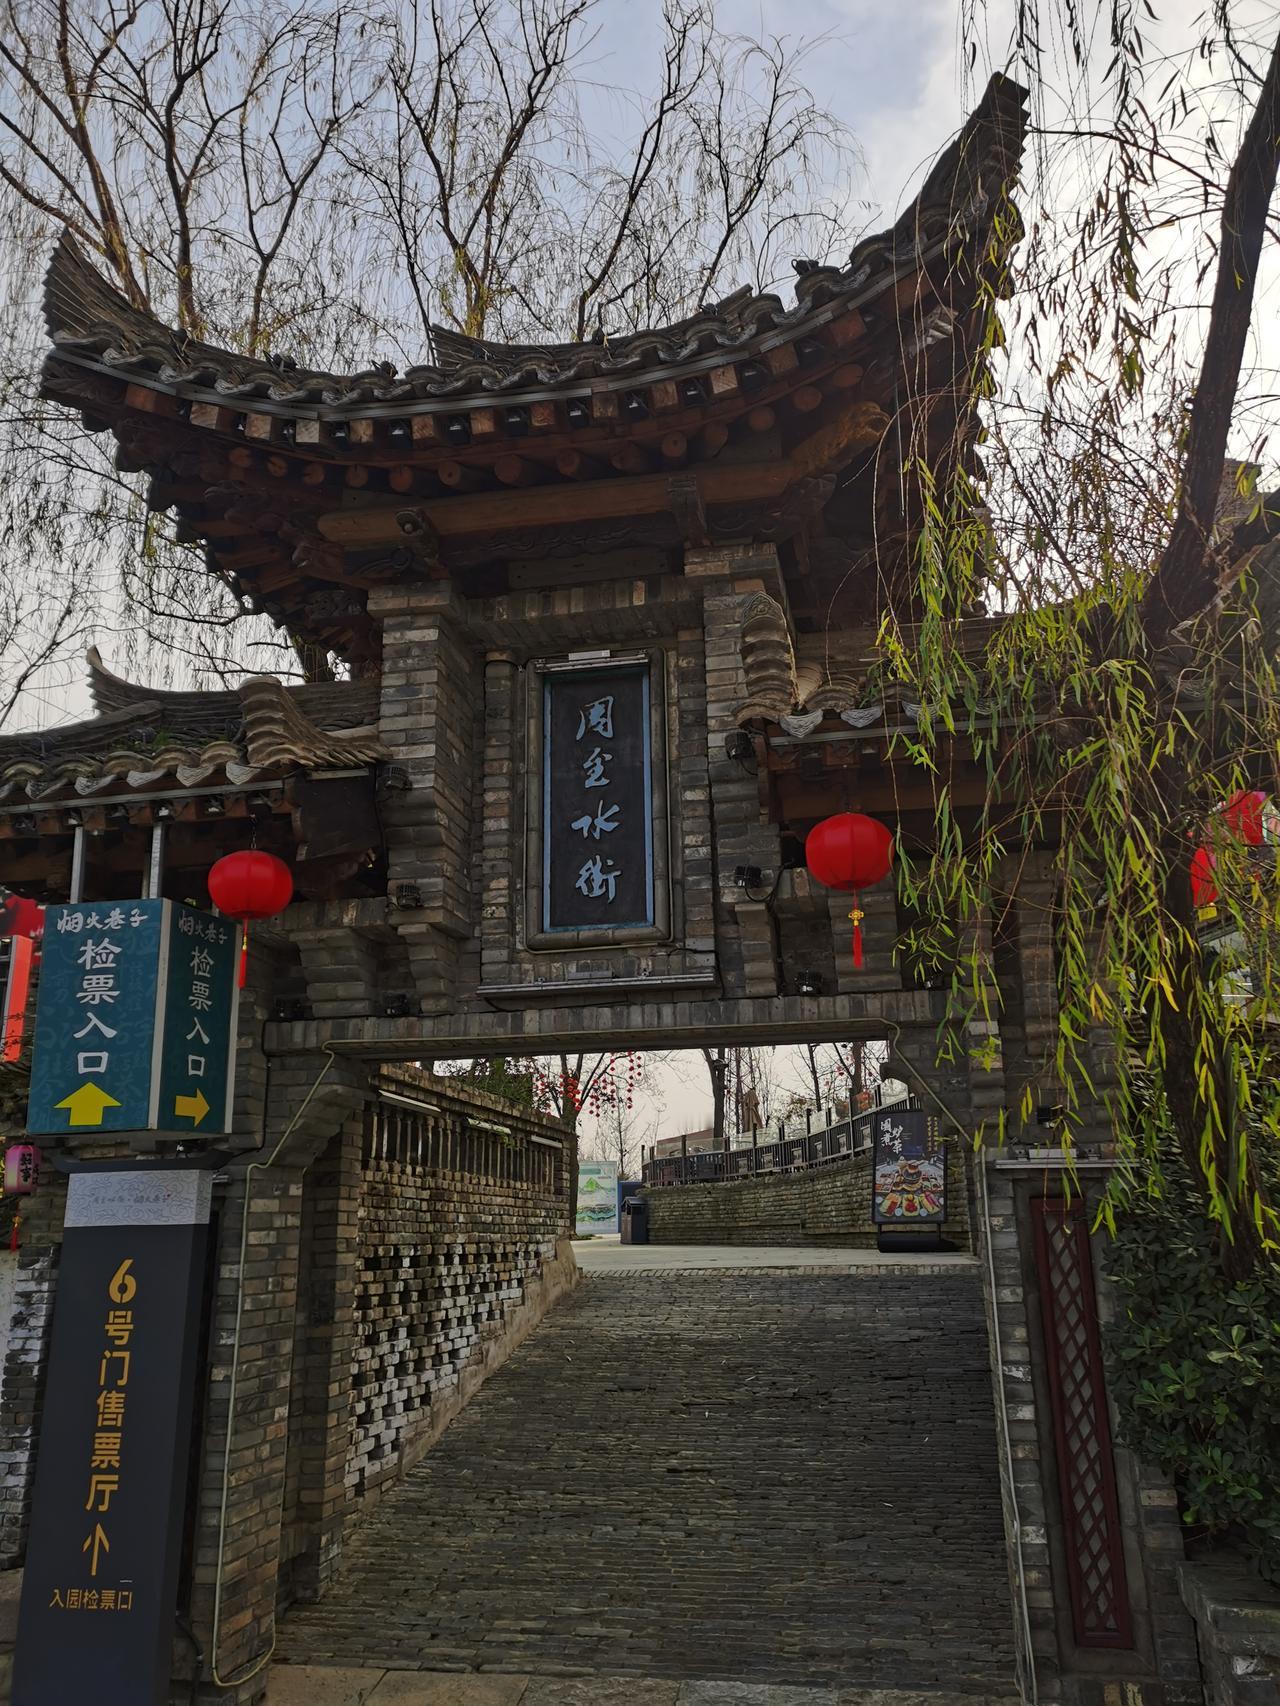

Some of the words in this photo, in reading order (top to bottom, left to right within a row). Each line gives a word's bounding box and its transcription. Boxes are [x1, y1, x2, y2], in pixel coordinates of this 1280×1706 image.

[57, 907, 149, 933] 烟火巷子
[73, 937, 122, 1074] 检票入口
[186, 946, 214, 1077] 检票入口
[85, 1258, 137, 1512] 6号门售票厅
[49, 1588, 133, 1610] 入园检票口
